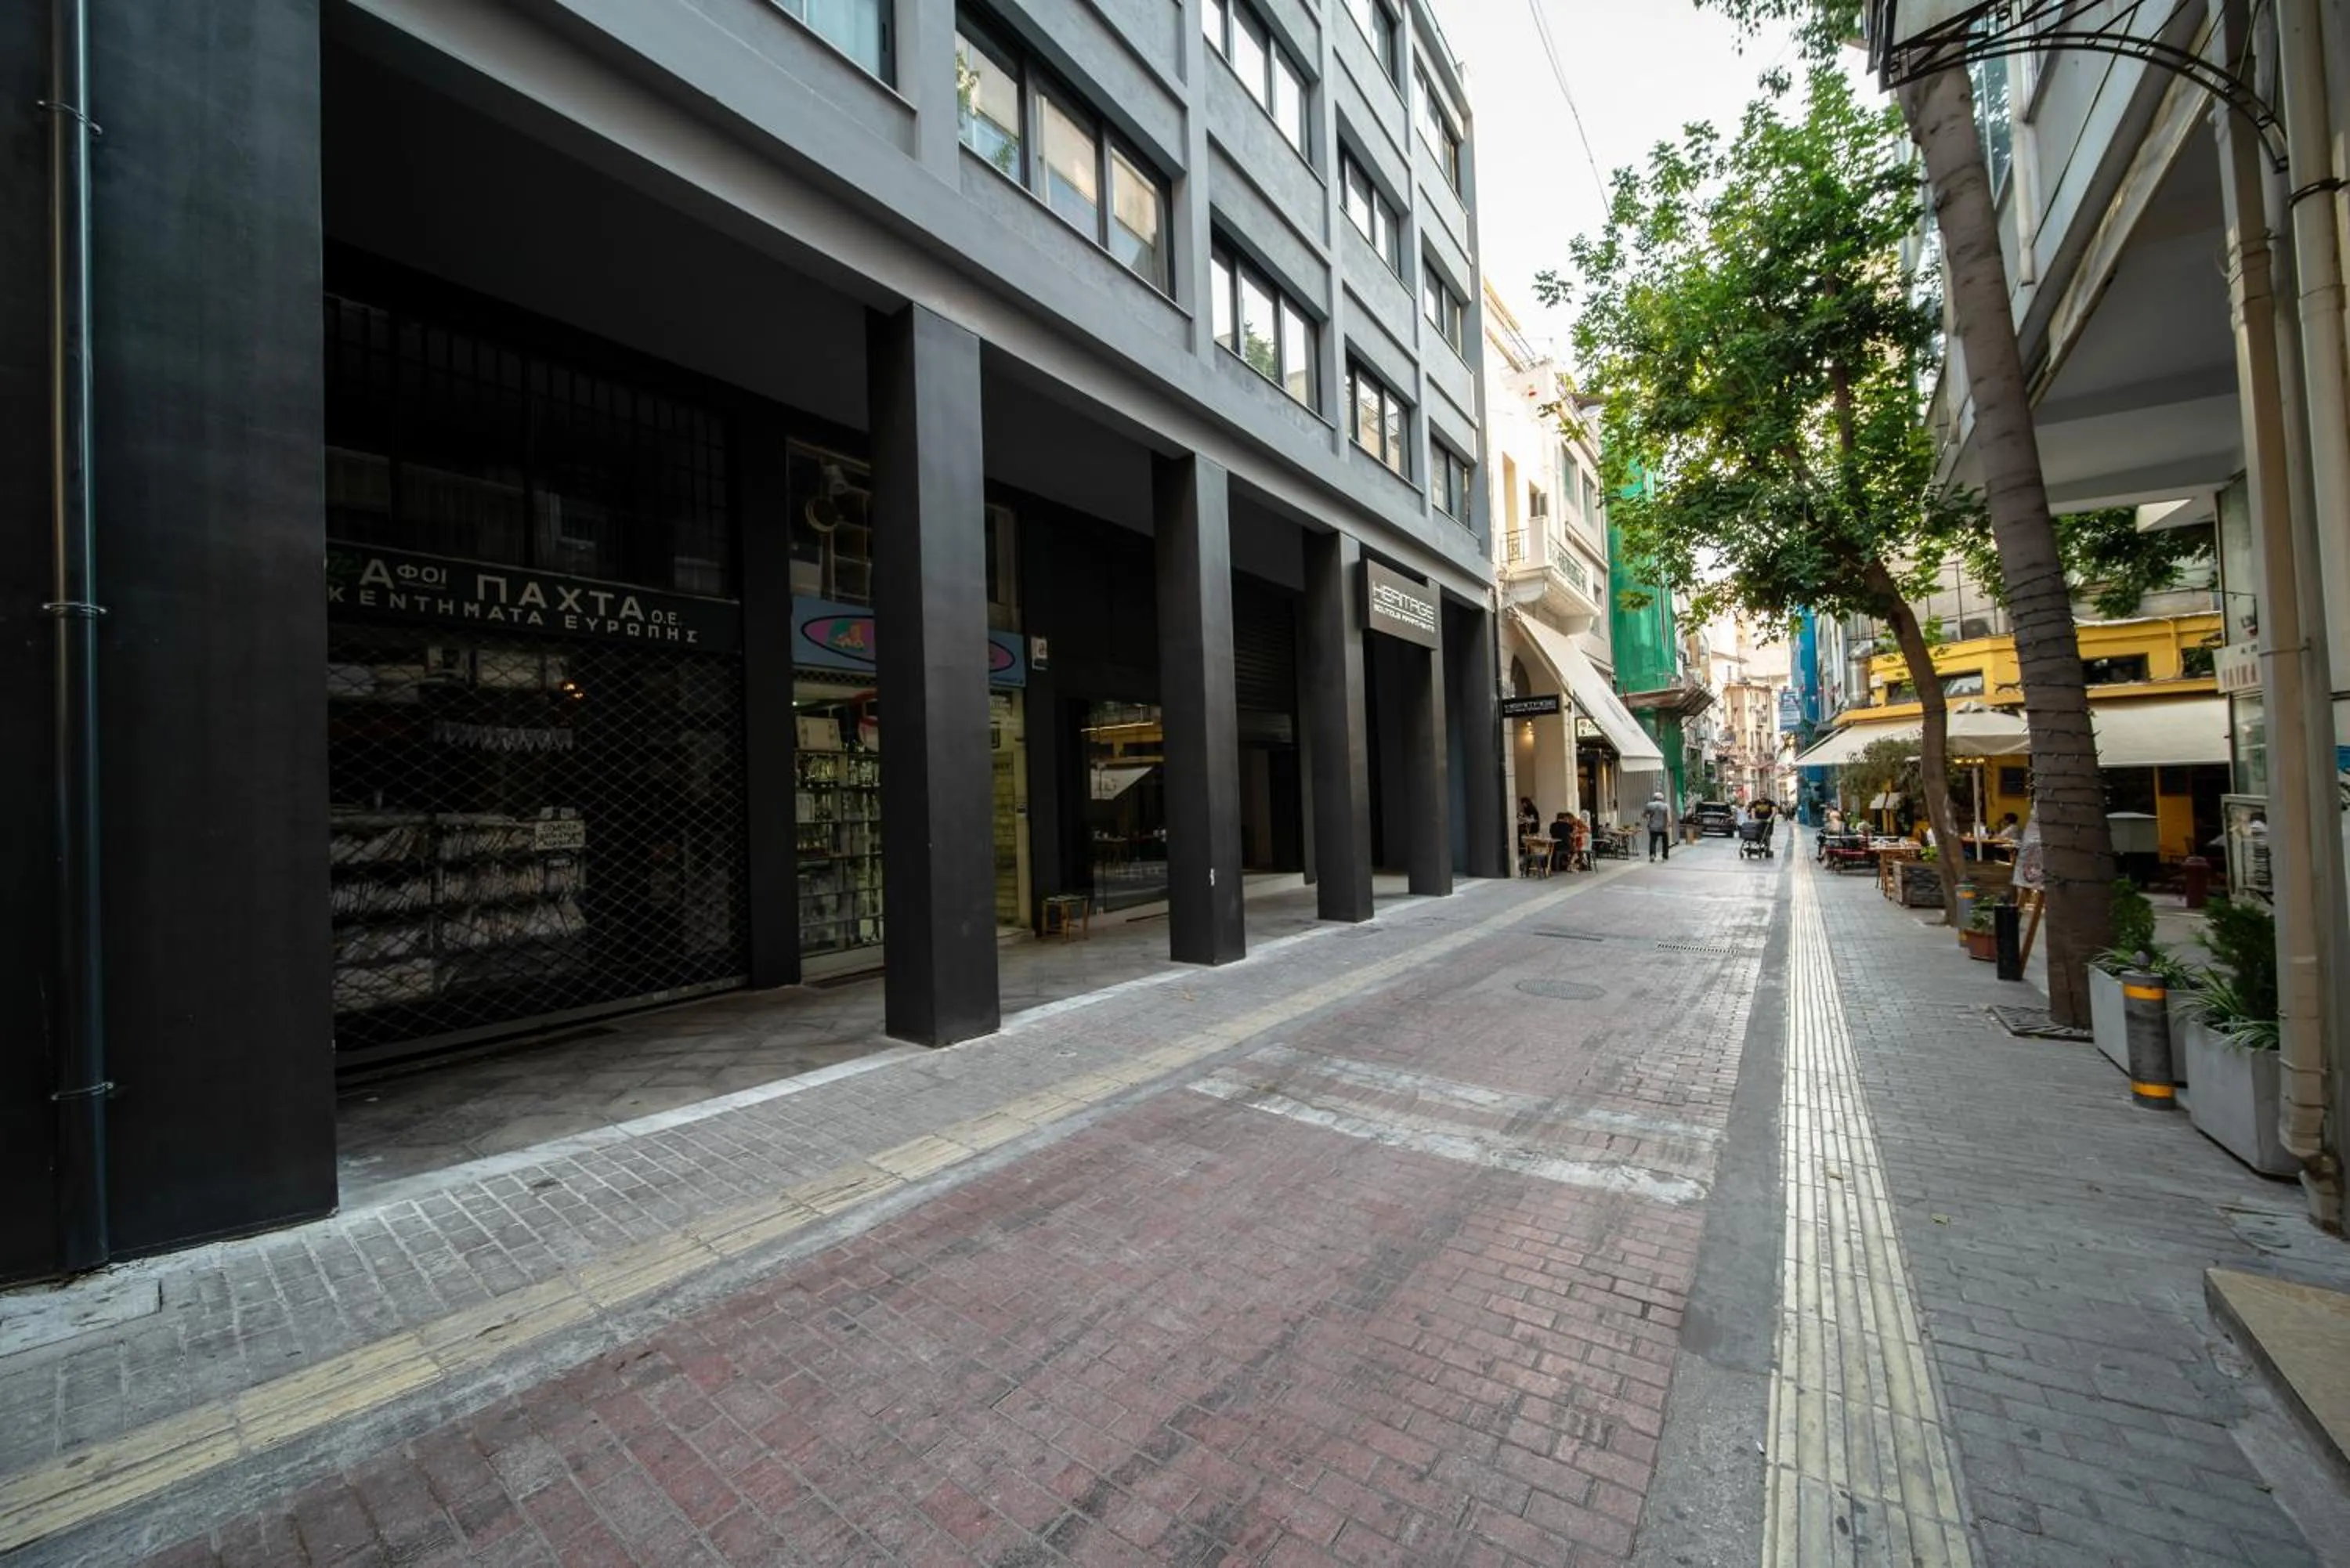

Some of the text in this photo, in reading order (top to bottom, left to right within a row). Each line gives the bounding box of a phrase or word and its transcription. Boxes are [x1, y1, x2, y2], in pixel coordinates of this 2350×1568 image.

[328, 586, 699, 644] ΚΕΝΤΗΜΑΤΑ ΕΥΡΩΠΗΣ
[476, 573, 645, 623] ΠΑΧΤΑ
[1372, 581, 1435, 620] HERITAGE
